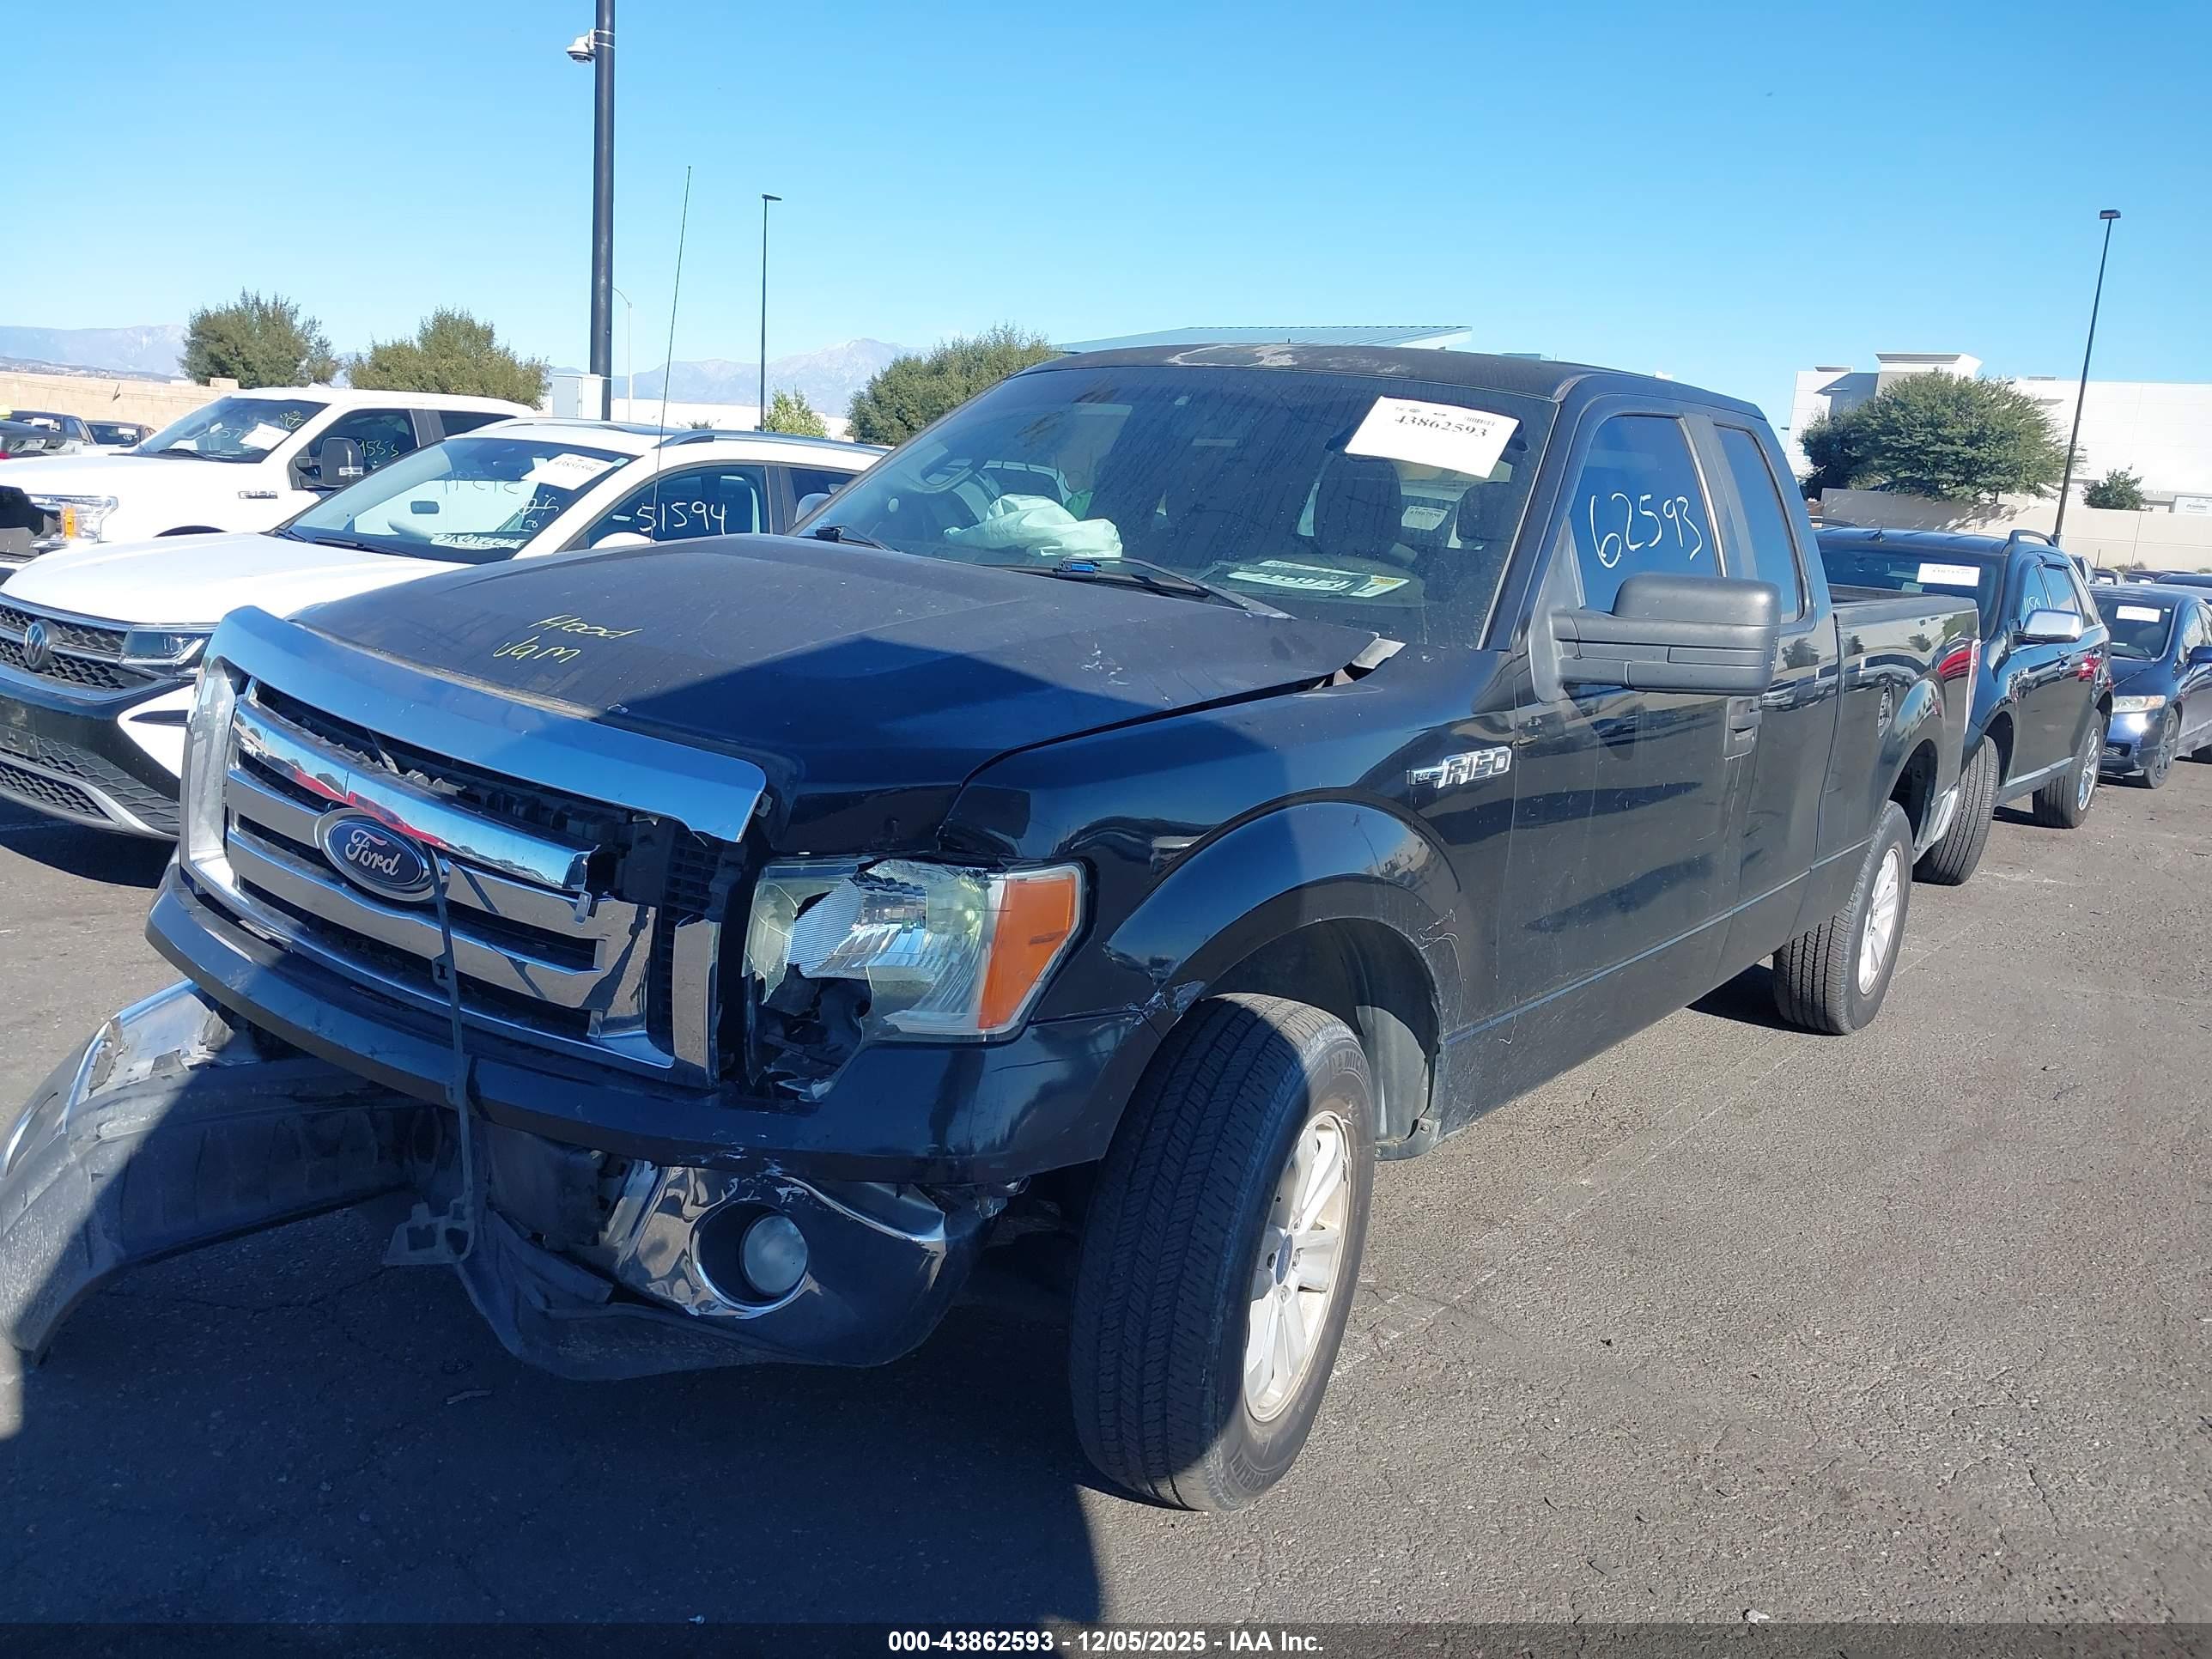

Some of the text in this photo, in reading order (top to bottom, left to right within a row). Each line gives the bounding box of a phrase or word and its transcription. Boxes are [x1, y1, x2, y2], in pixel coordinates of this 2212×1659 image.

[1395, 414, 1488, 438] 43862593
[1589, 492, 1703, 568] 62593
[526, 614, 644, 640] Hood
[344, 829, 399, 876] Ford
